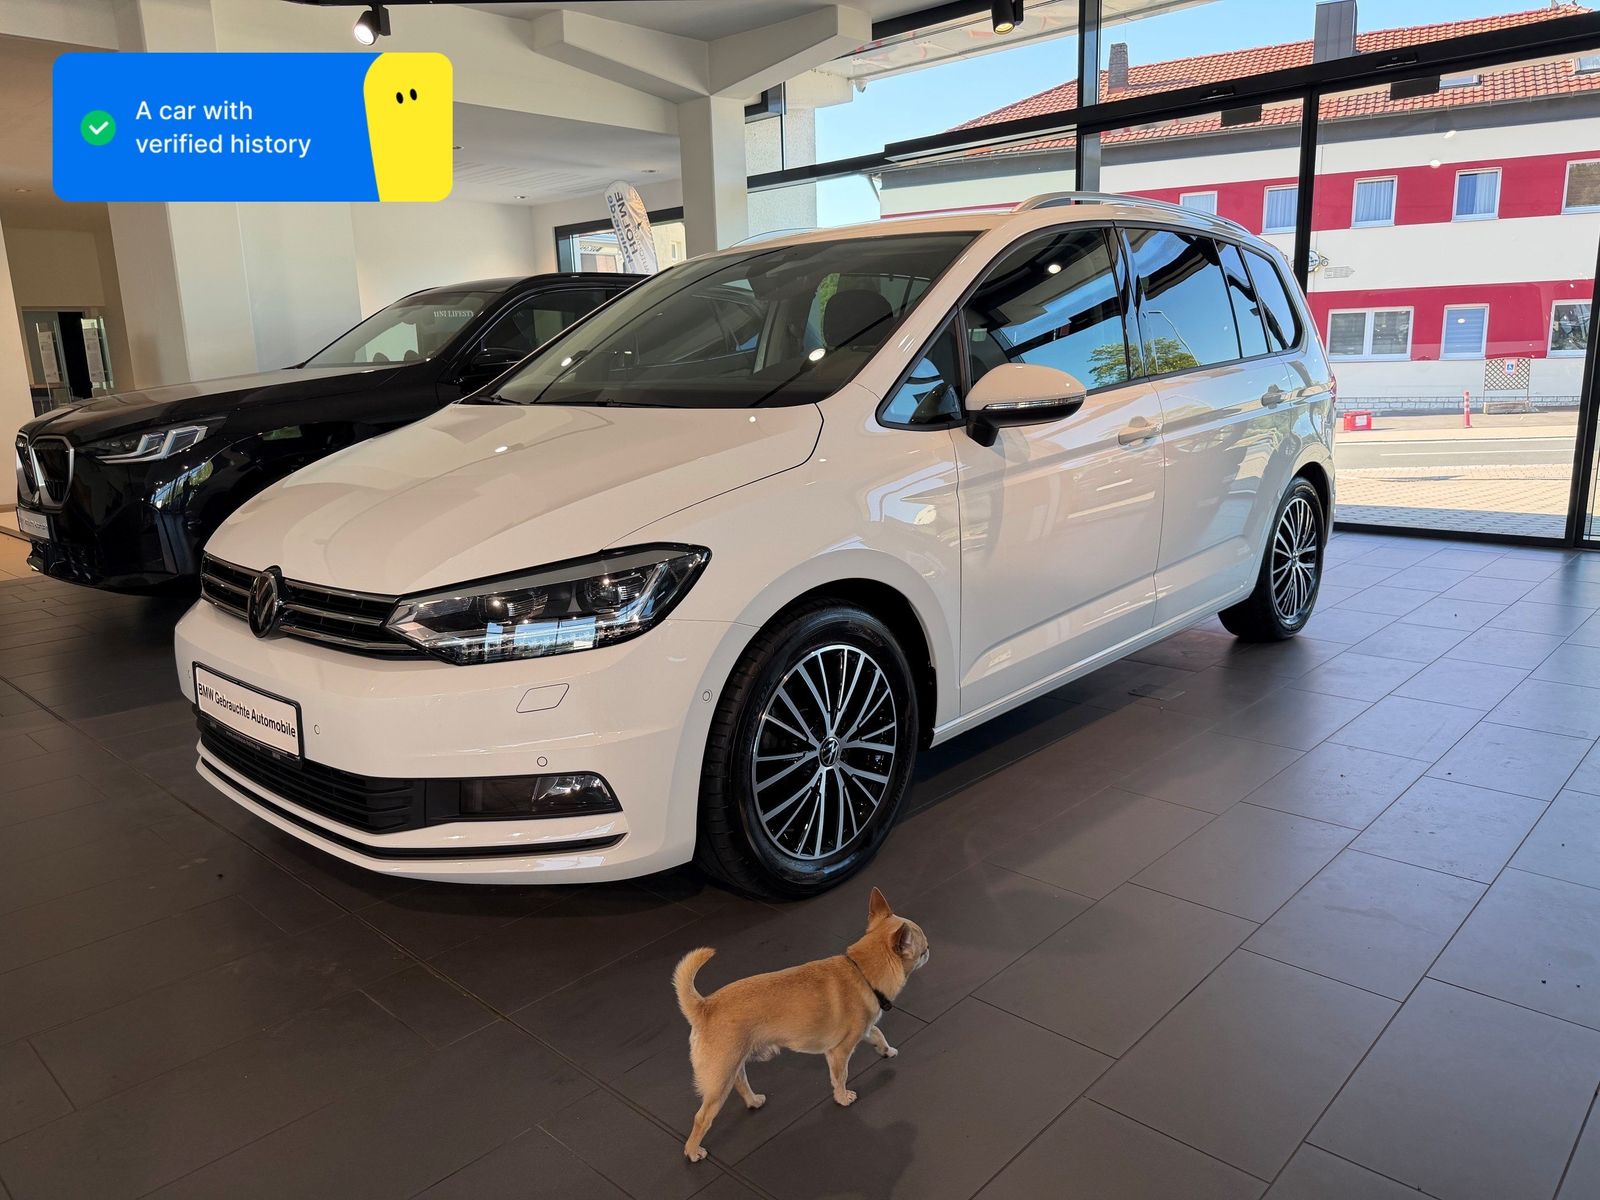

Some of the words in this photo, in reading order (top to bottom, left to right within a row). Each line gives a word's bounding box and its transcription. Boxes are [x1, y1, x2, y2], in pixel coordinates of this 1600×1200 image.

[198, 682, 215, 702] BMW
[215, 691, 251, 720] Gebrauchte
[251, 708, 297, 738] Automobile
